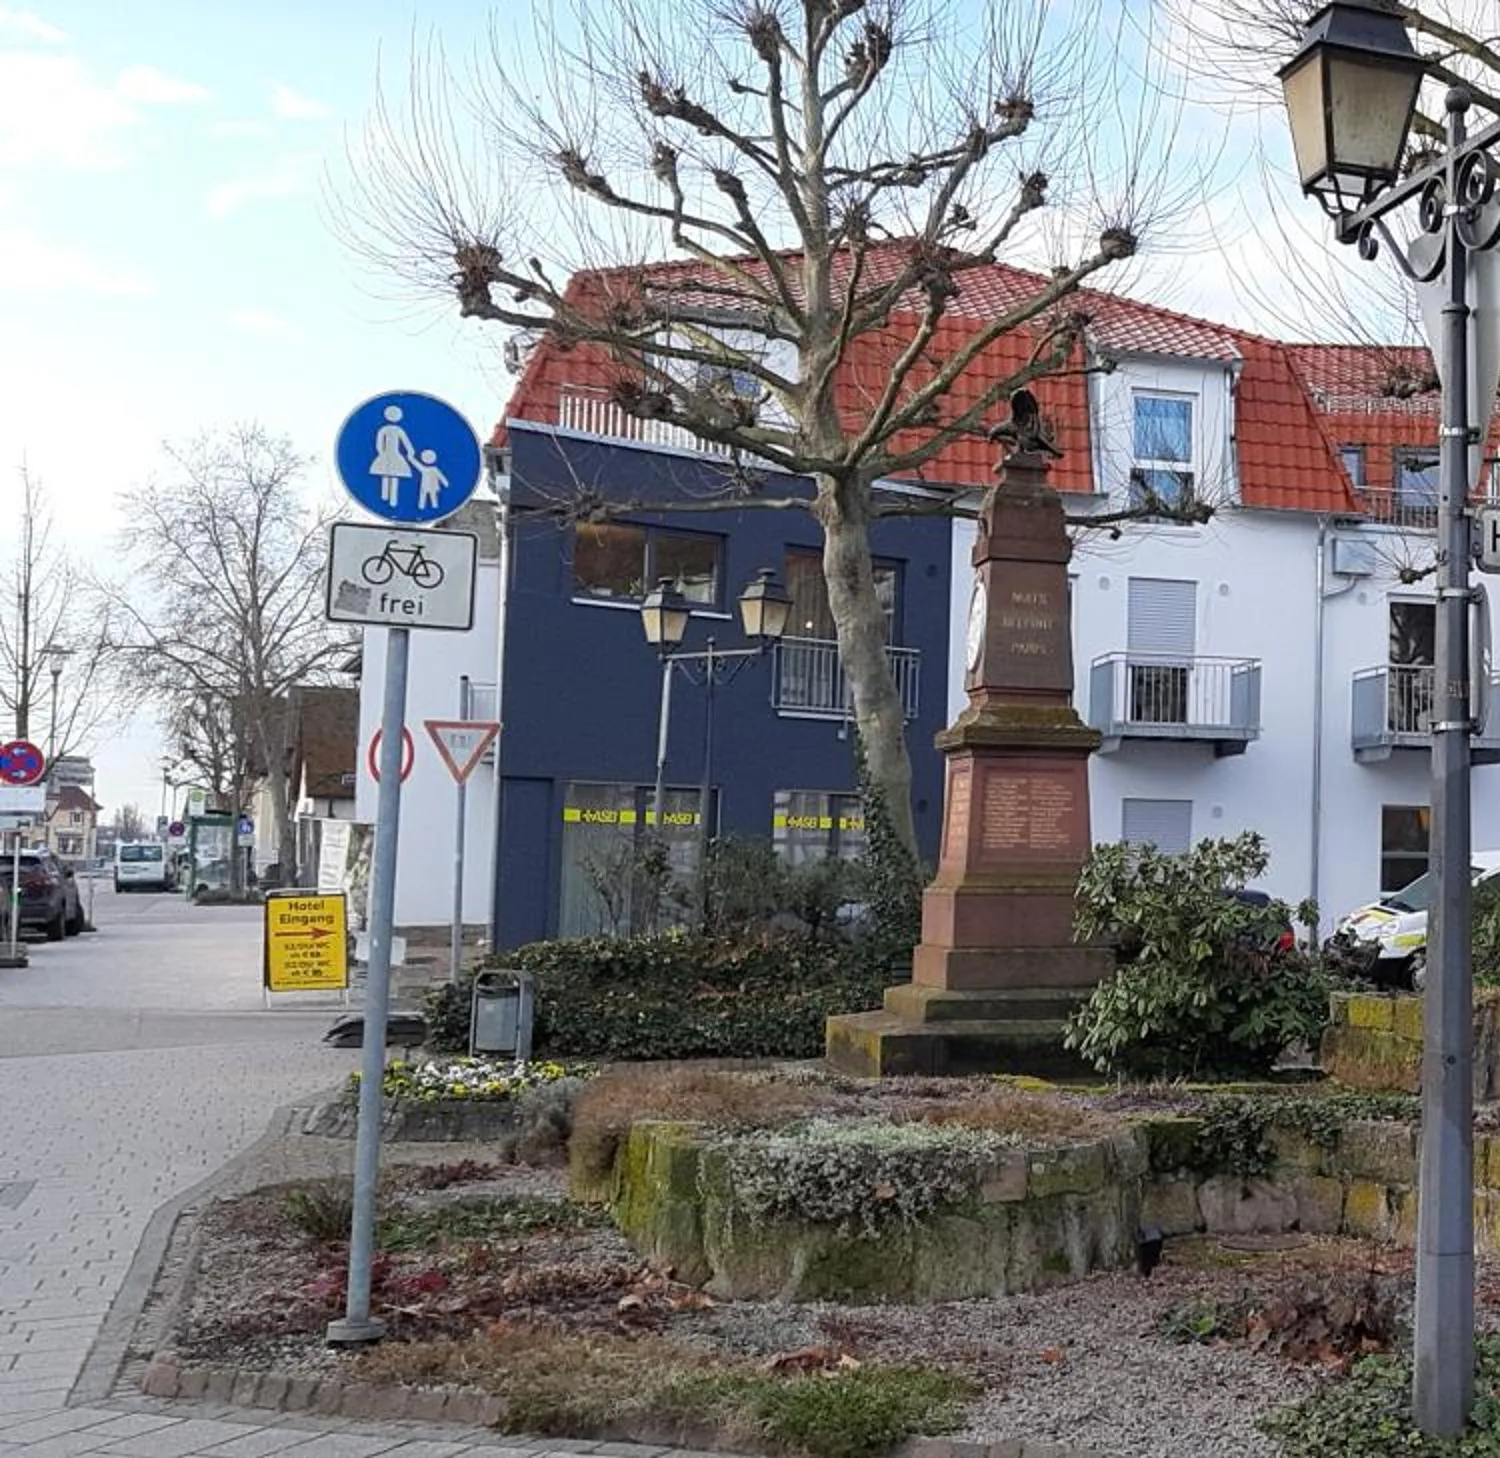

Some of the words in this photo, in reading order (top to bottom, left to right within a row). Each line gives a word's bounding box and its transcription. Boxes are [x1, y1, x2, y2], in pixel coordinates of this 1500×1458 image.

[380, 593, 423, 615] frei
[288, 900, 325, 911] Hotel
[279, 913, 335, 926] Eingang
